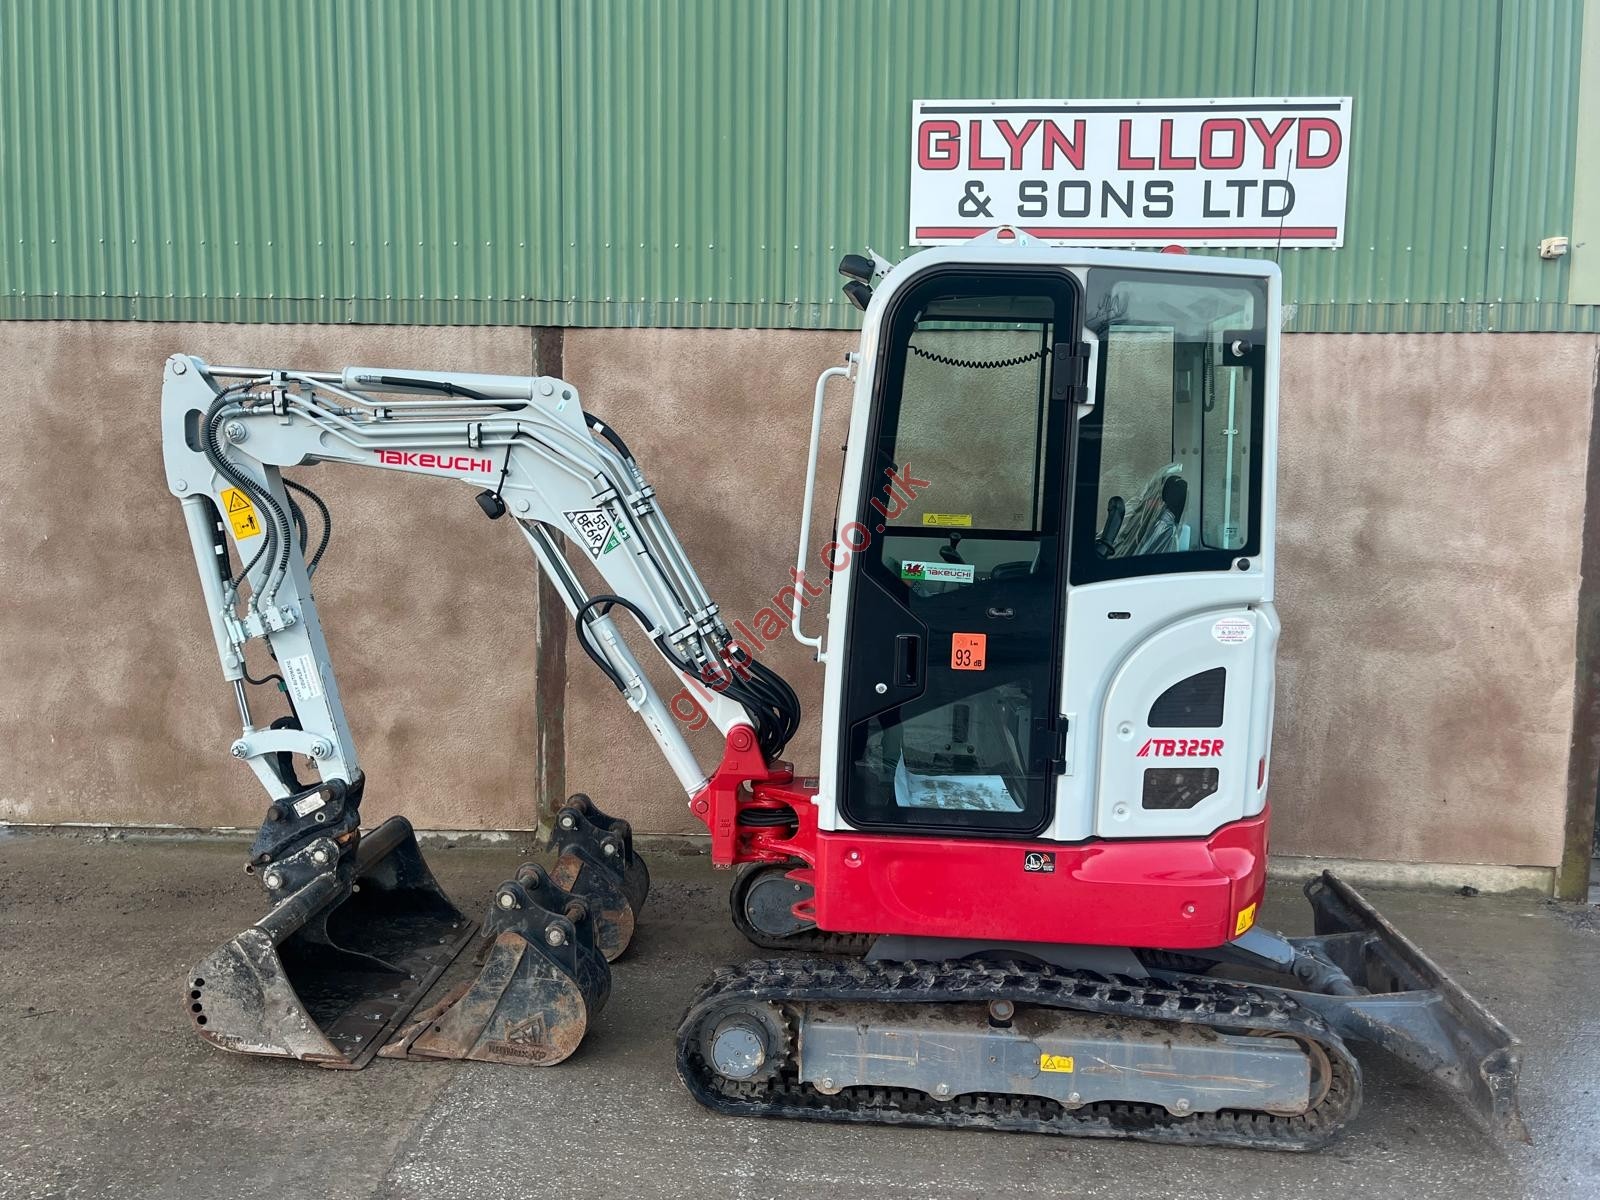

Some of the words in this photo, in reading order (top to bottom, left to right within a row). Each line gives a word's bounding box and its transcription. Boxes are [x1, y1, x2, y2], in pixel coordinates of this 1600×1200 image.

[918, 119, 1086, 171] GLYN
[1117, 117, 1343, 171] LLOYD
[957, 180, 994, 218] &
[1017, 180, 1175, 218] SONS
[1203, 179, 1296, 218] LTD
[374, 450, 492, 473] TAKEUCHI
[577, 513, 602, 546] BE6R
[592, 513, 609, 531] 55
[927, 569, 971, 578] TAKEUCHI
[955, 649, 971, 667] 93
[973, 659, 982, 667] dB
[1152, 739, 1224, 757] TB325R
